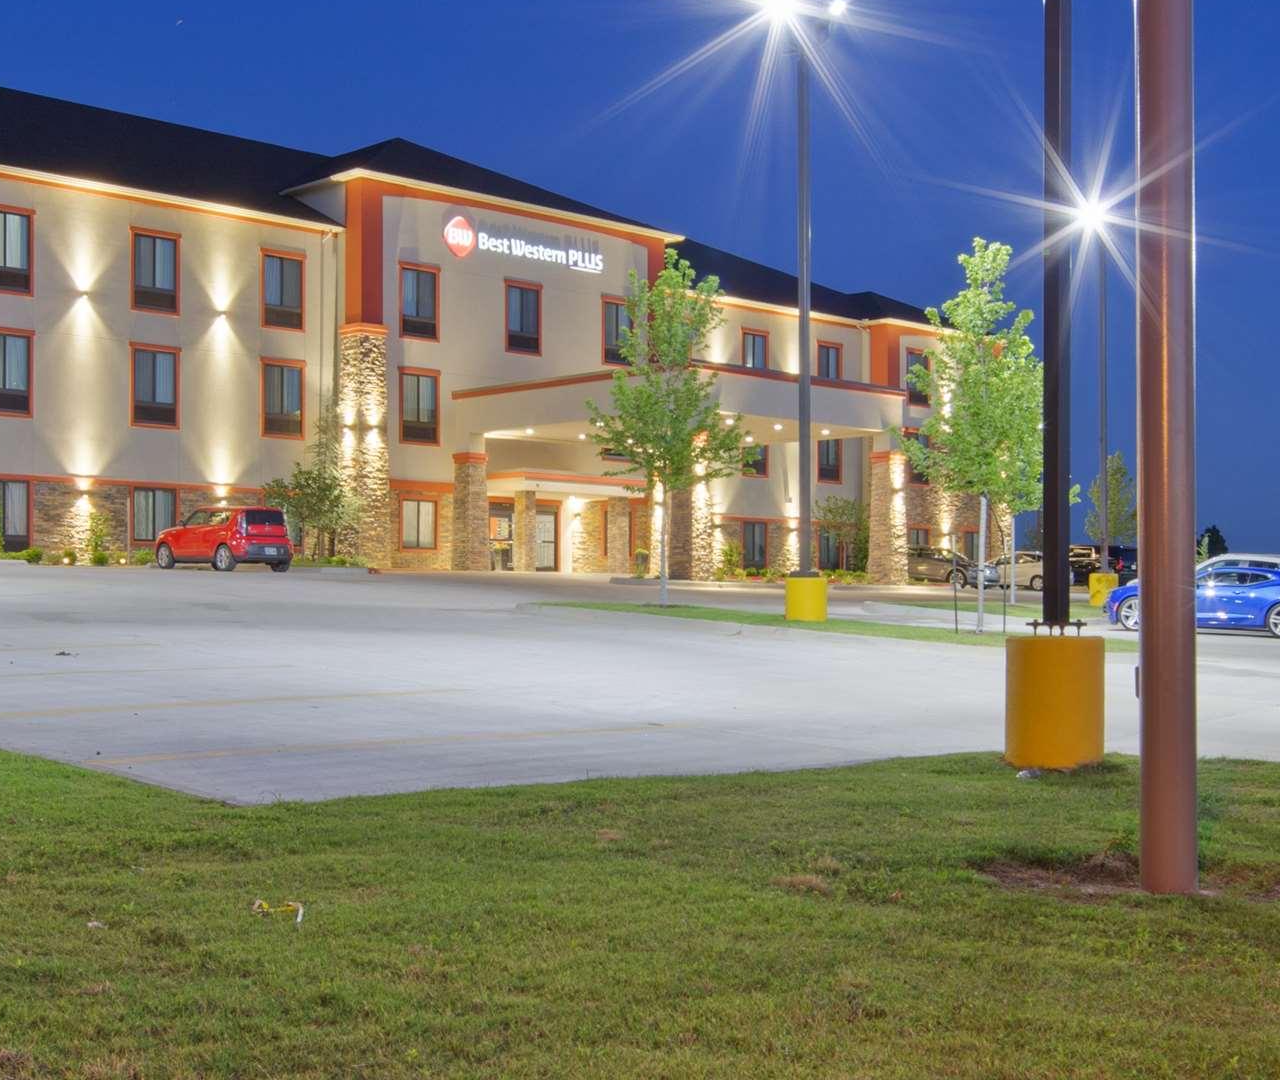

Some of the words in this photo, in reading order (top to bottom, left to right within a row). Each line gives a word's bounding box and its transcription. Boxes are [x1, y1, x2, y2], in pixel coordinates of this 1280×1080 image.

[478, 233, 510, 254] Best
[511, 239, 567, 265] Western
[569, 249, 603, 270] PLUS
